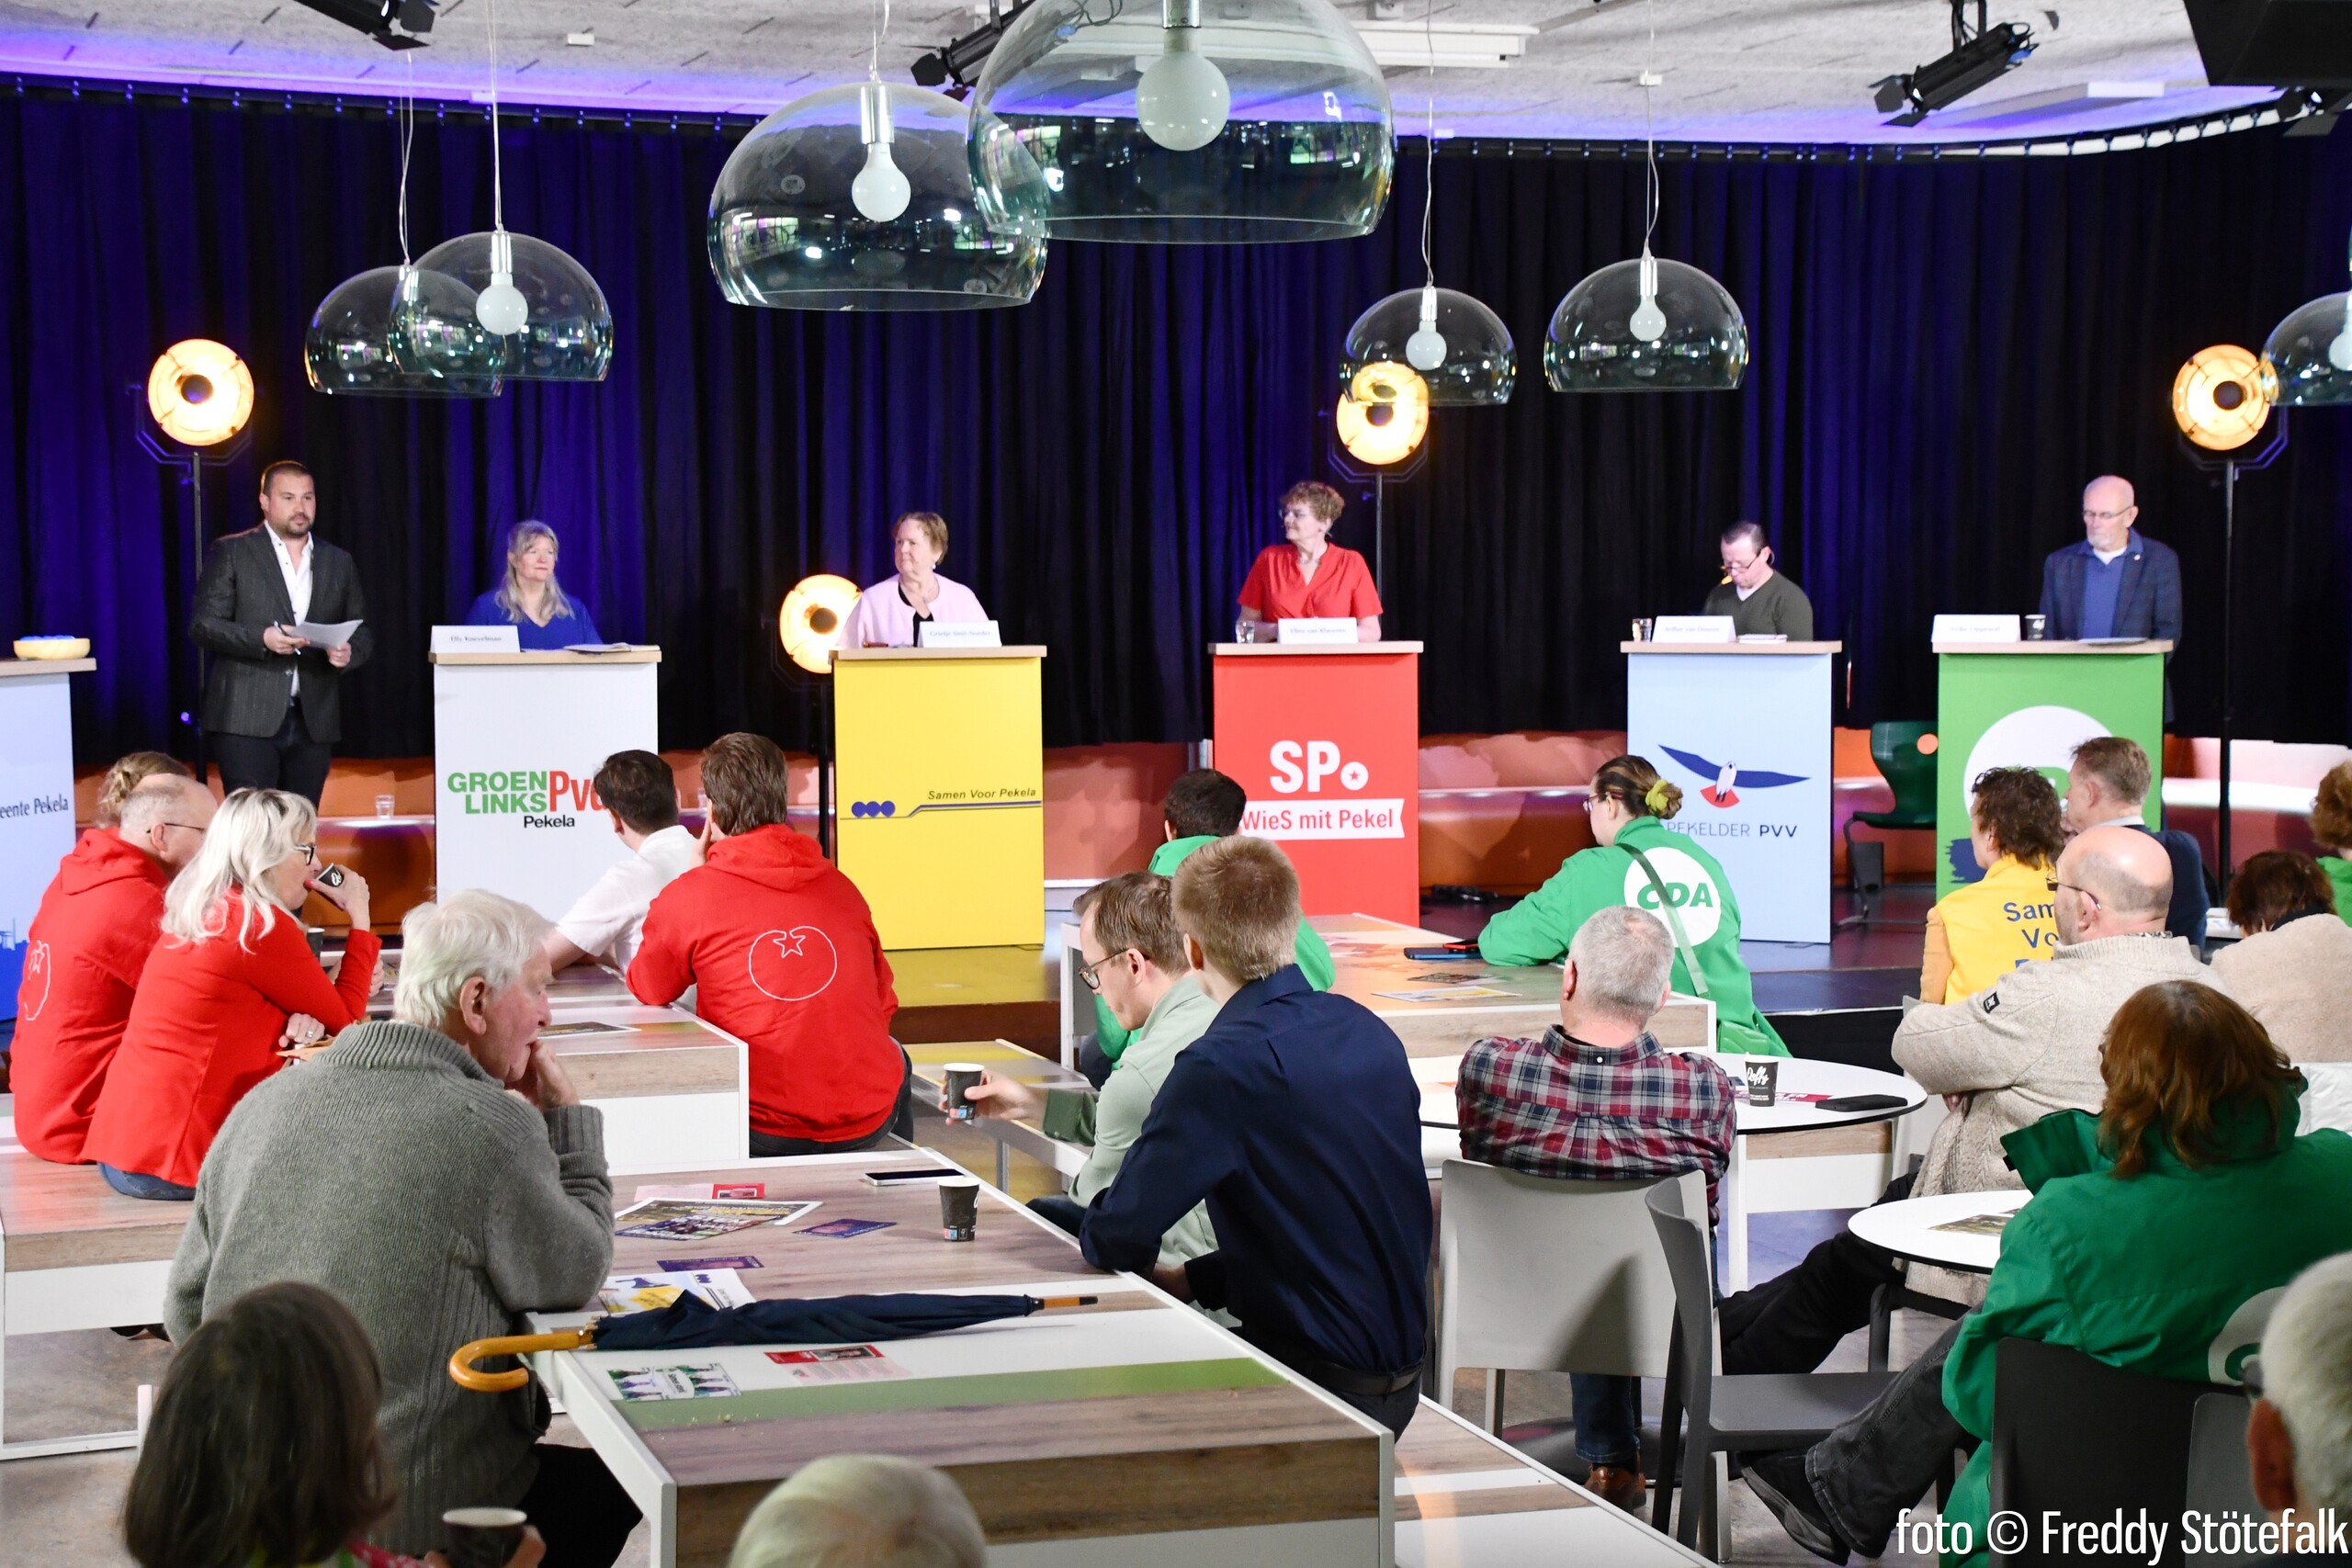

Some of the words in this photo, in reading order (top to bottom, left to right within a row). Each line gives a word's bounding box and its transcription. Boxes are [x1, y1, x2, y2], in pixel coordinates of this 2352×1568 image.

[447, 771, 548, 793] GROEN
[465, 793, 548, 814] LINKS
[928, 790, 966, 800] Samen
[970, 789, 996, 798] Voor
[999, 787, 1036, 797] Pekela
[34, 794, 69, 814] Pekela
[524, 815, 575, 829] Pekela
[1299, 809, 1331, 829] mit
[1340, 808, 1393, 829] Pekel
[1759, 824, 1797, 838] PVV
[1637, 882, 1713, 910] CDA
